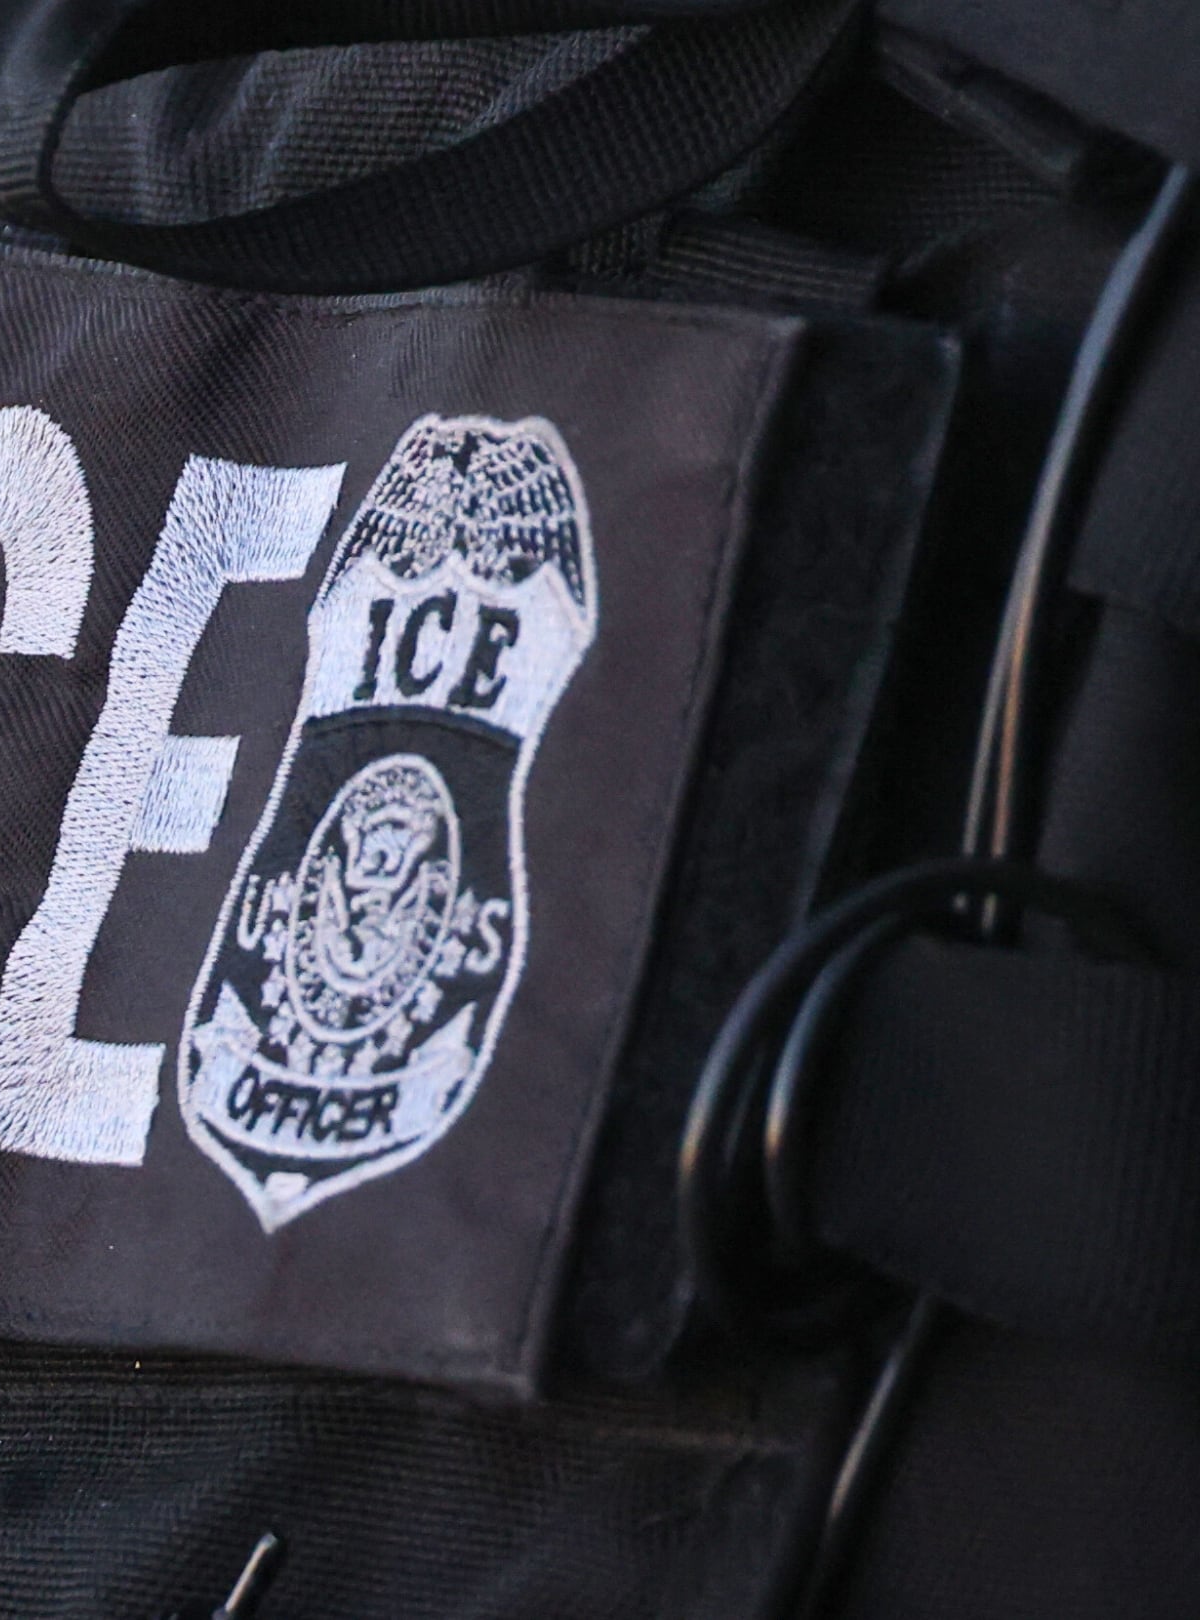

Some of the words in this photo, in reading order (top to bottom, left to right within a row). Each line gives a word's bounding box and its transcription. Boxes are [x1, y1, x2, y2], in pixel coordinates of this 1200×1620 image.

[353, 588, 519, 708] ICE
[237, 873, 275, 950] U
[466, 898, 509, 974] S
[227, 1067, 402, 1142] OFFICER
